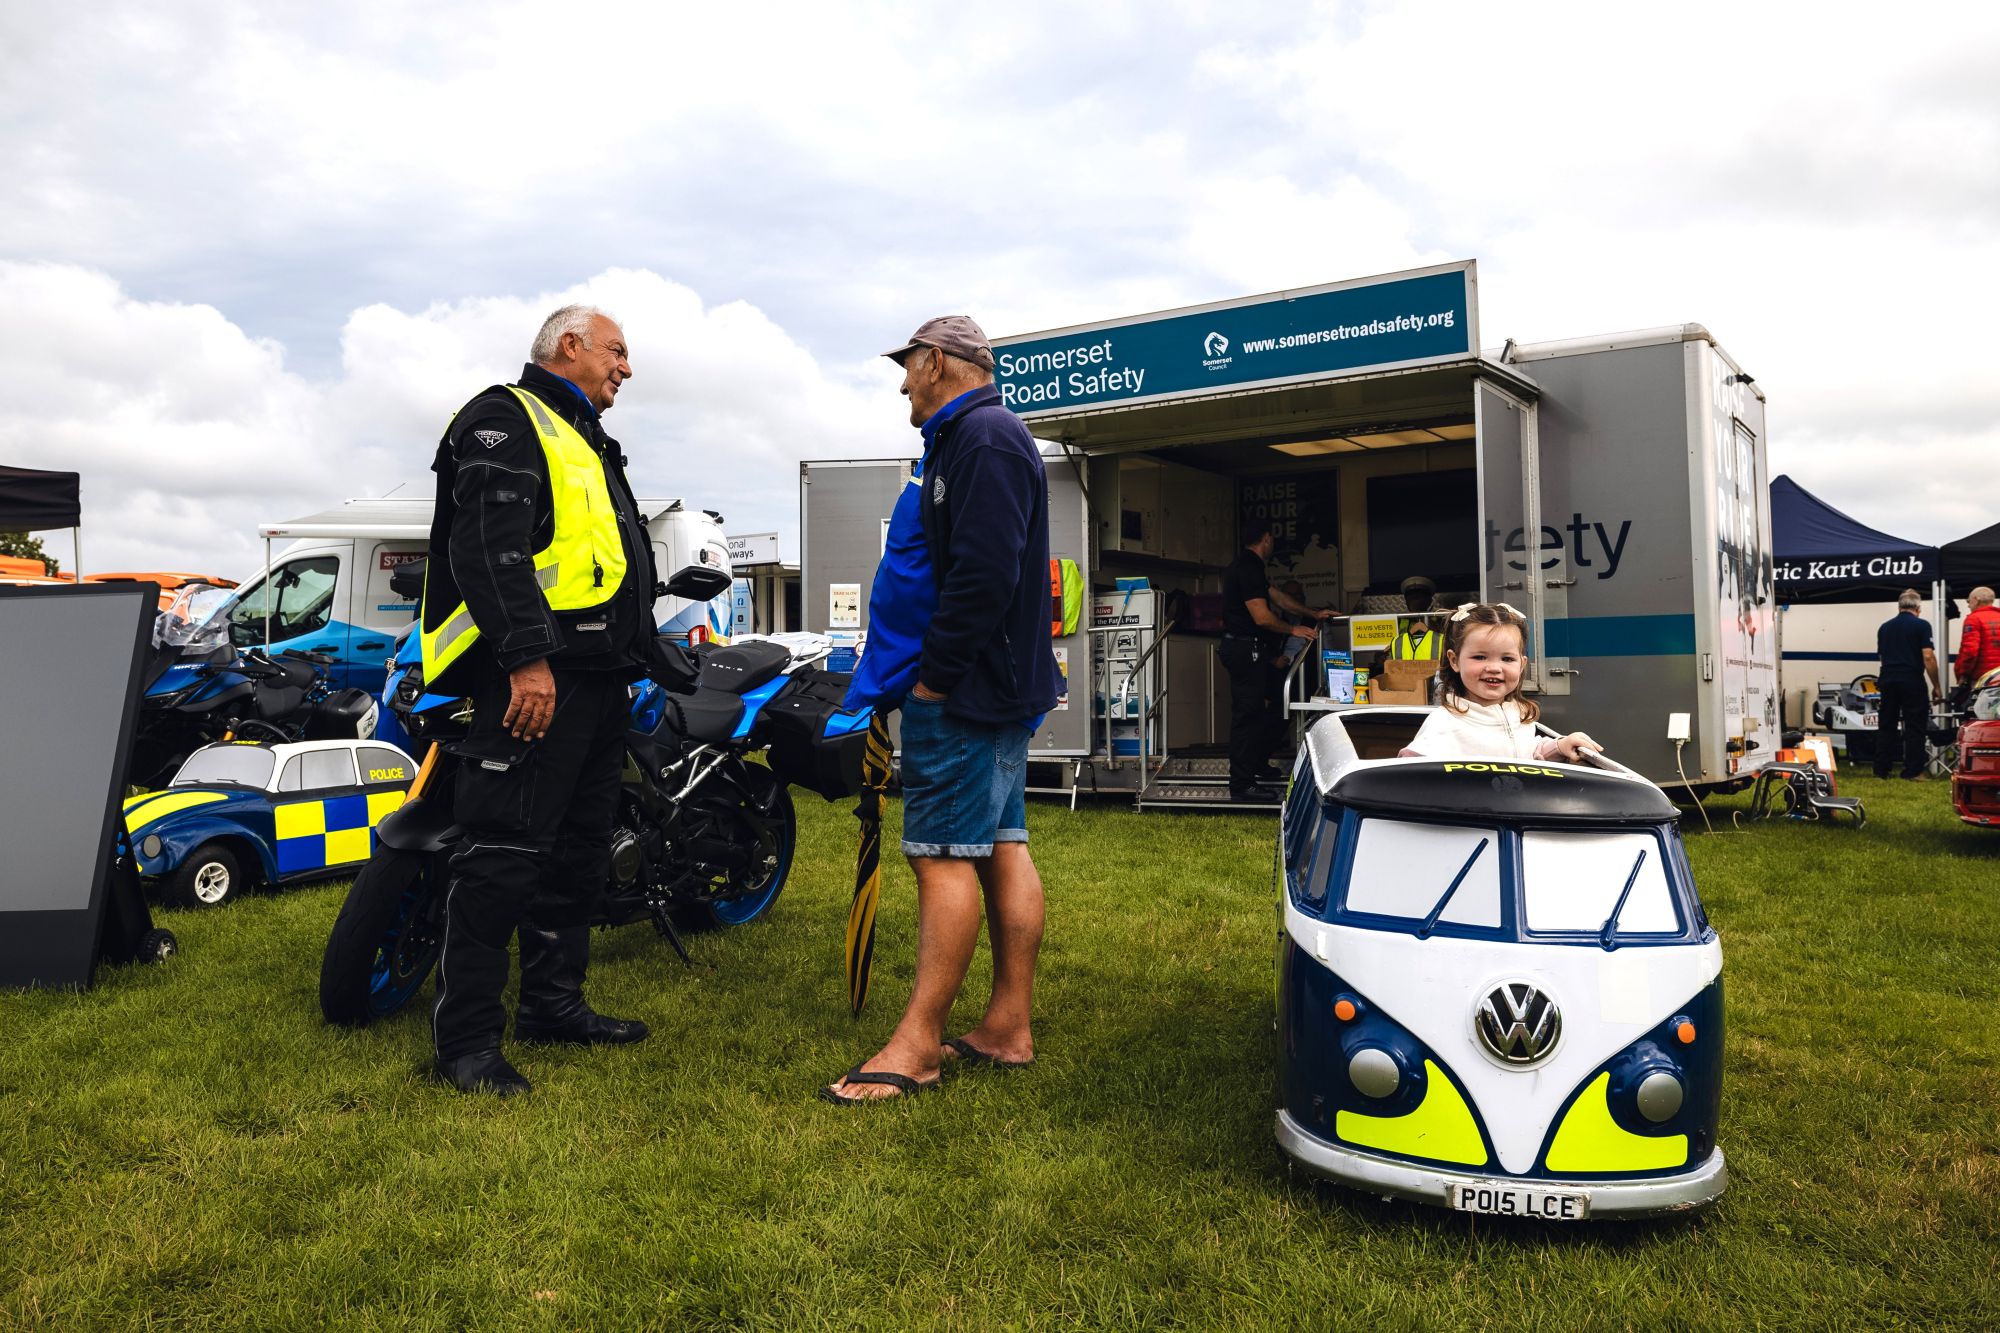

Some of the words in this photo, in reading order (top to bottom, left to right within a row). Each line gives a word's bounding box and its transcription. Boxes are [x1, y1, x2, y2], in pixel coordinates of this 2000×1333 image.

[1243, 310, 1455, 354] www.somersetroadsafety.org
[1000, 339, 1113, 377] Somerset
[1202, 356, 1233, 367] Somerset
[1001, 375, 1061, 406] Road
[1069, 367, 1145, 397] Safety
[1243, 482, 1297, 502] RAISE
[1242, 502, 1298, 521] YOUR
[728, 539, 746, 549] onal
[1807, 560, 1861, 580] Kart
[1867, 556, 1923, 576] Club
[369, 767, 404, 780] POLICE
[1443, 764, 1564, 777] POLICE
[1461, 1188, 1516, 1212] PO15
[1526, 1194, 1575, 1218] LCE
